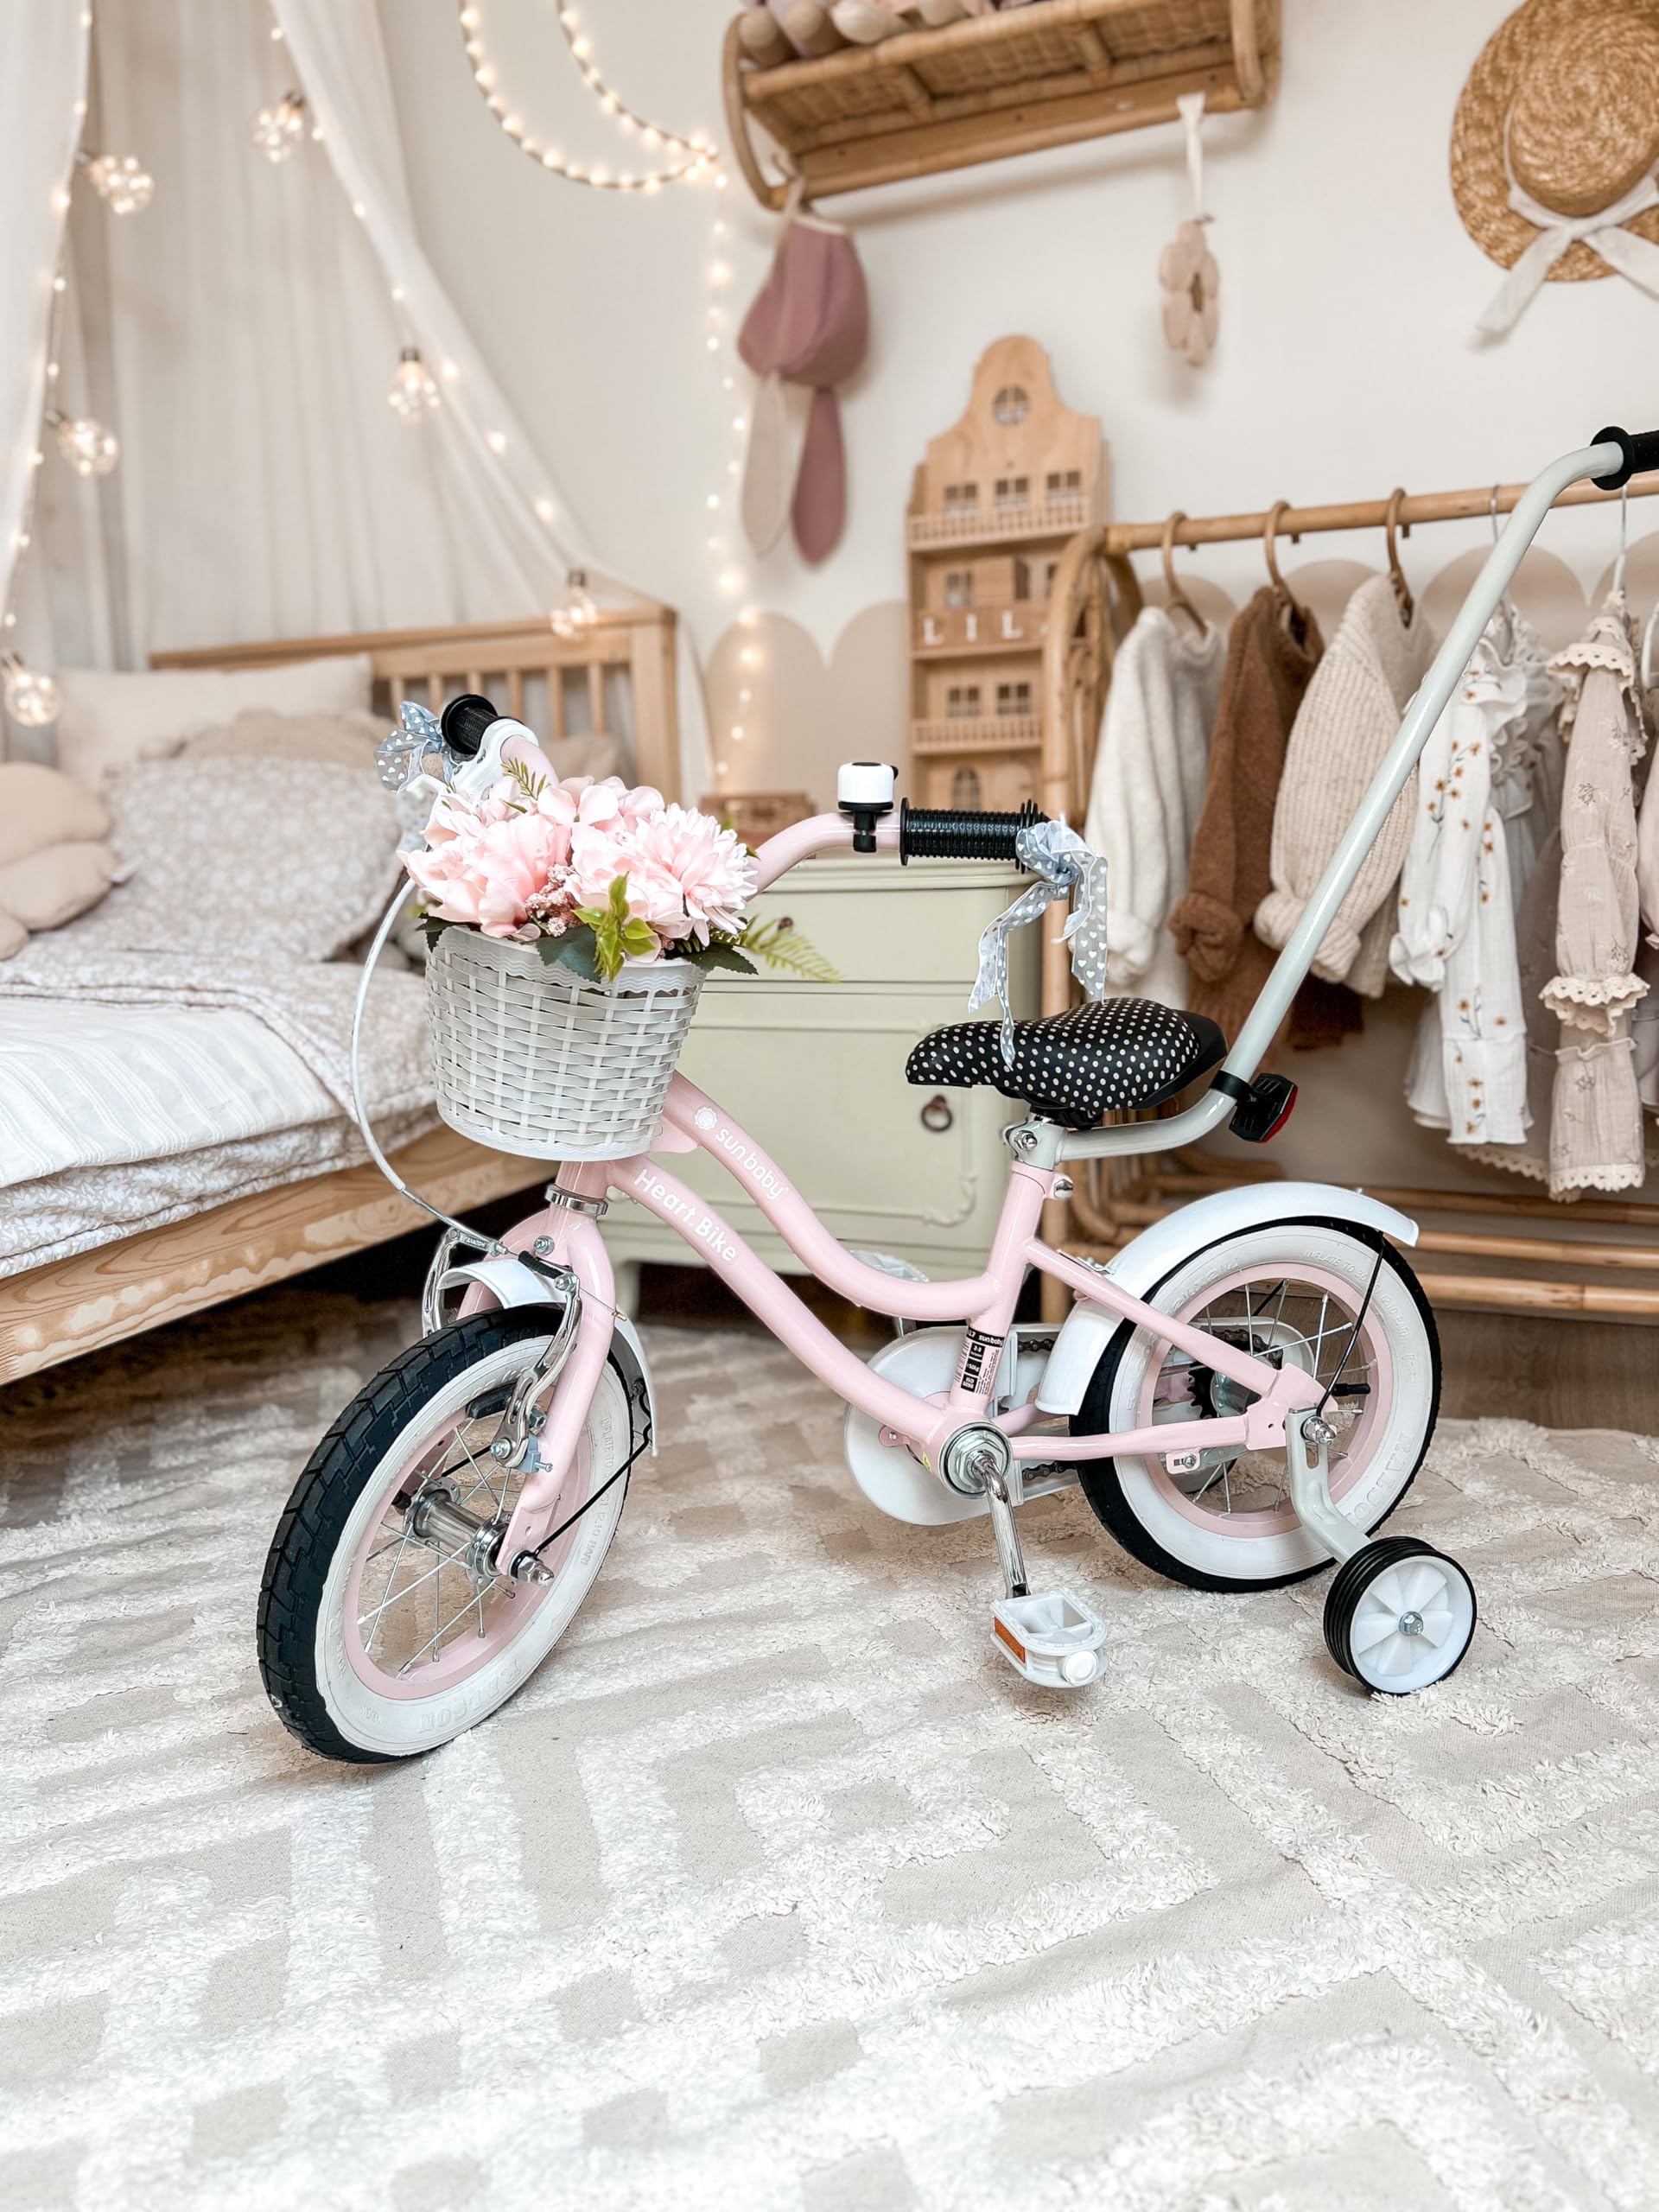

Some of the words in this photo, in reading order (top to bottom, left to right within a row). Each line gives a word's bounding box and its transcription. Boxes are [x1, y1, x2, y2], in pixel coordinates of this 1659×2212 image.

[715, 1128, 746, 1163] sun
[744, 1151, 783, 1200] baby
[633, 1168, 696, 1227] Heart
[695, 1216, 736, 1261] Bike
